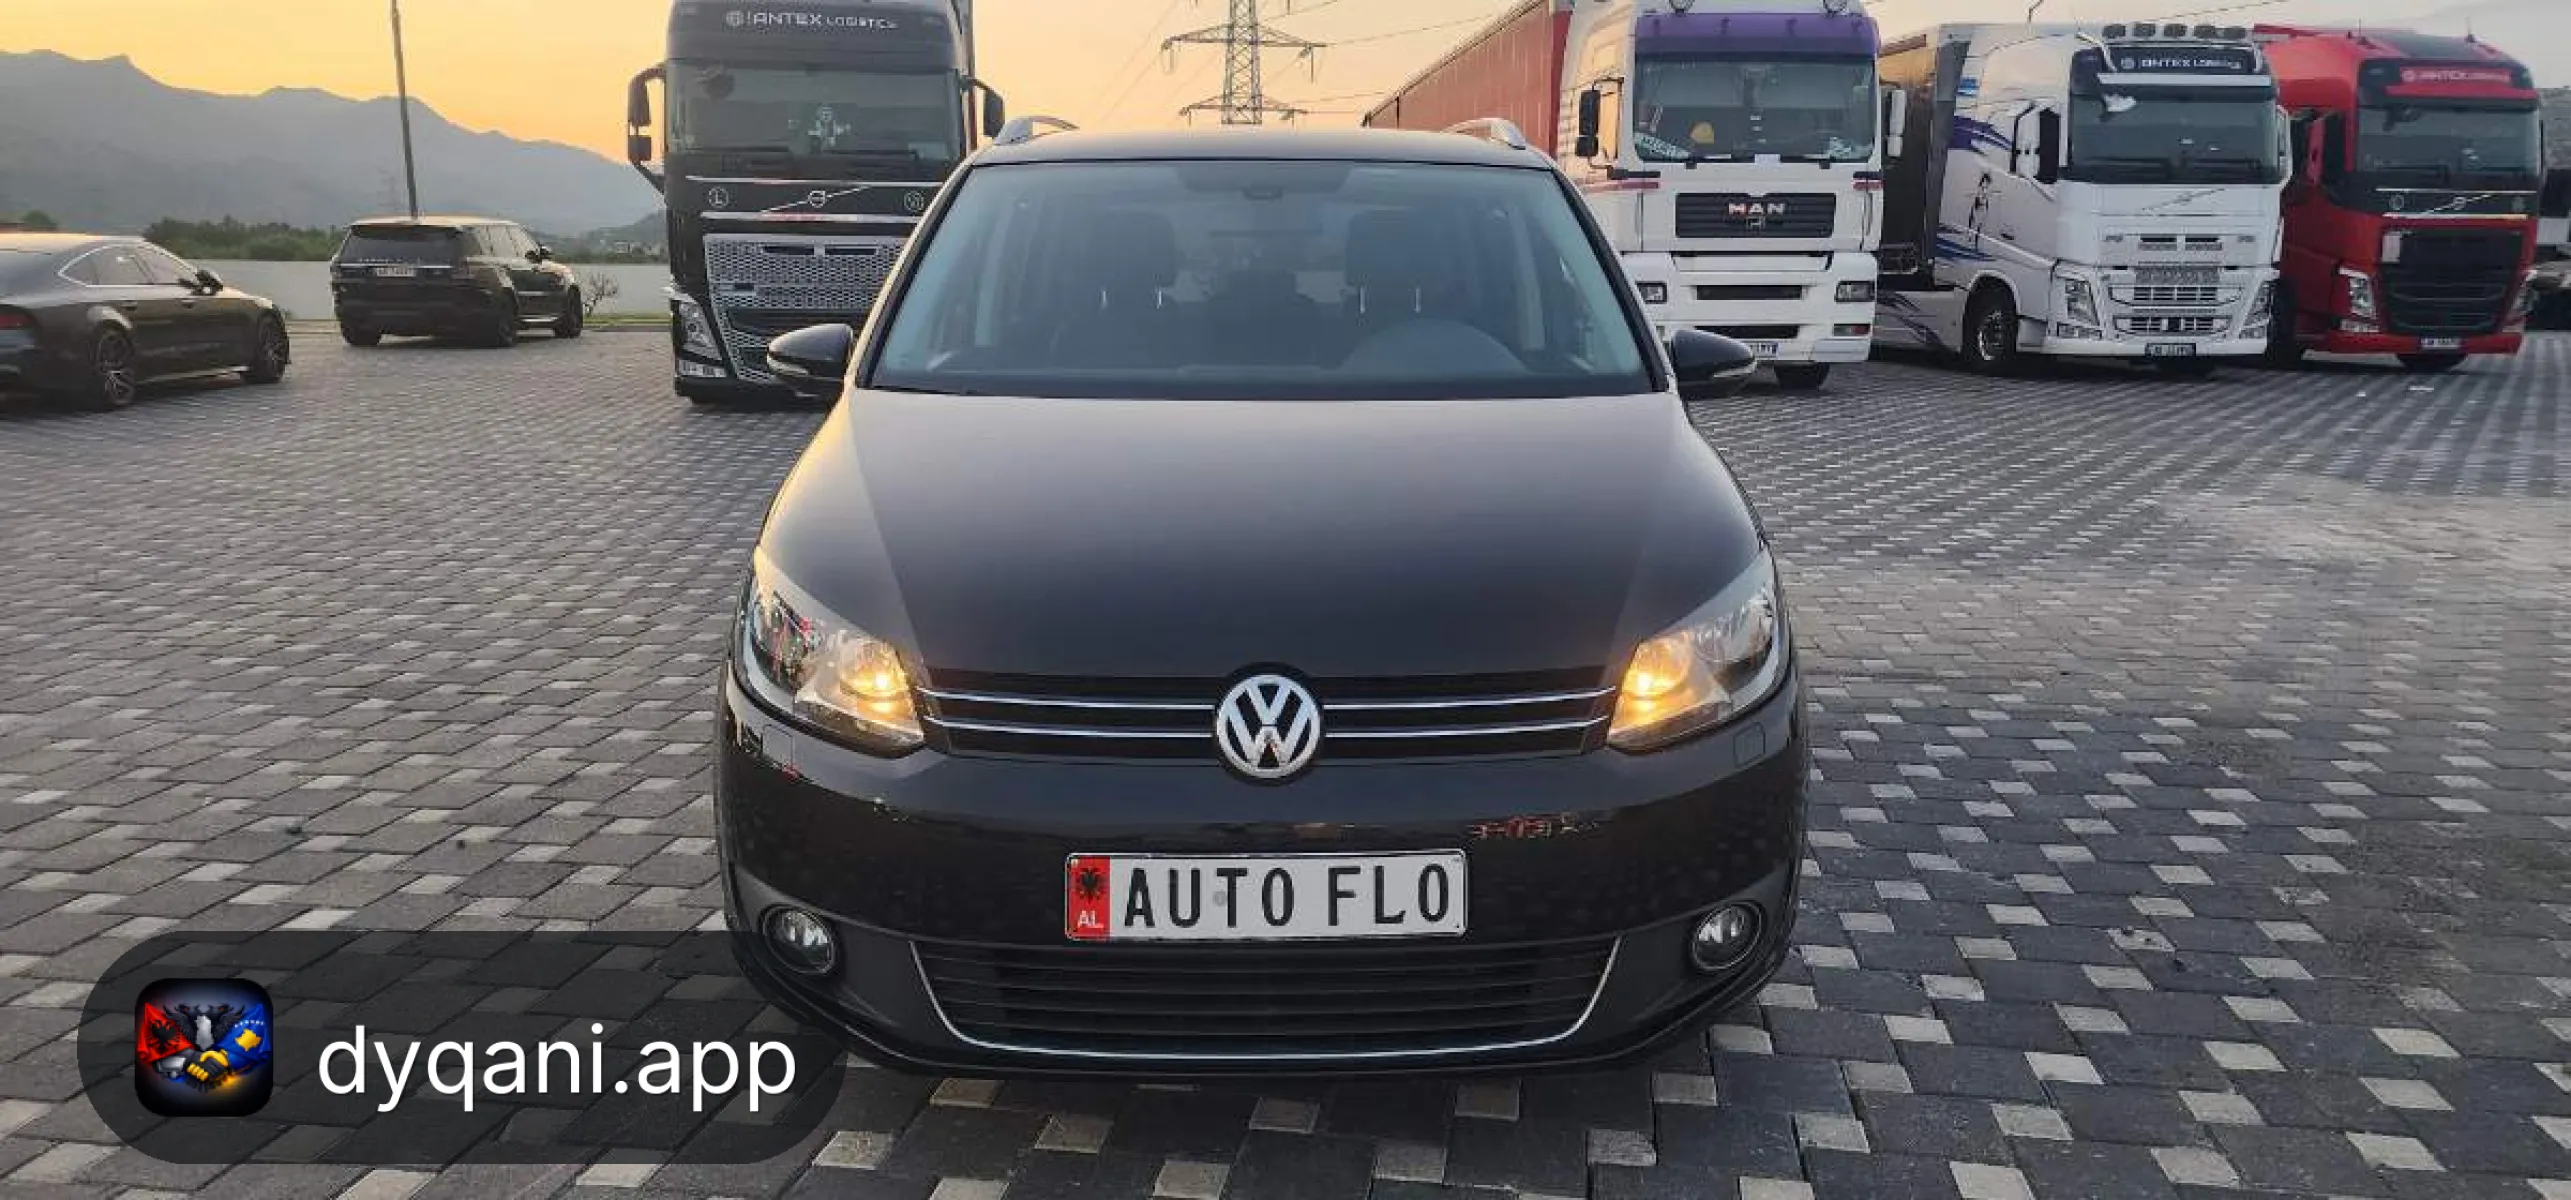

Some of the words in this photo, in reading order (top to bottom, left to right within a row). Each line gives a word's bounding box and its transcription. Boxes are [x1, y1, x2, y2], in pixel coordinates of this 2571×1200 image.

[1728, 203, 1785, 215] MAN
[1124, 867, 1296, 928] AUTO
[1327, 863, 1449, 926] FLO
[1077, 911, 1104, 929] AL
